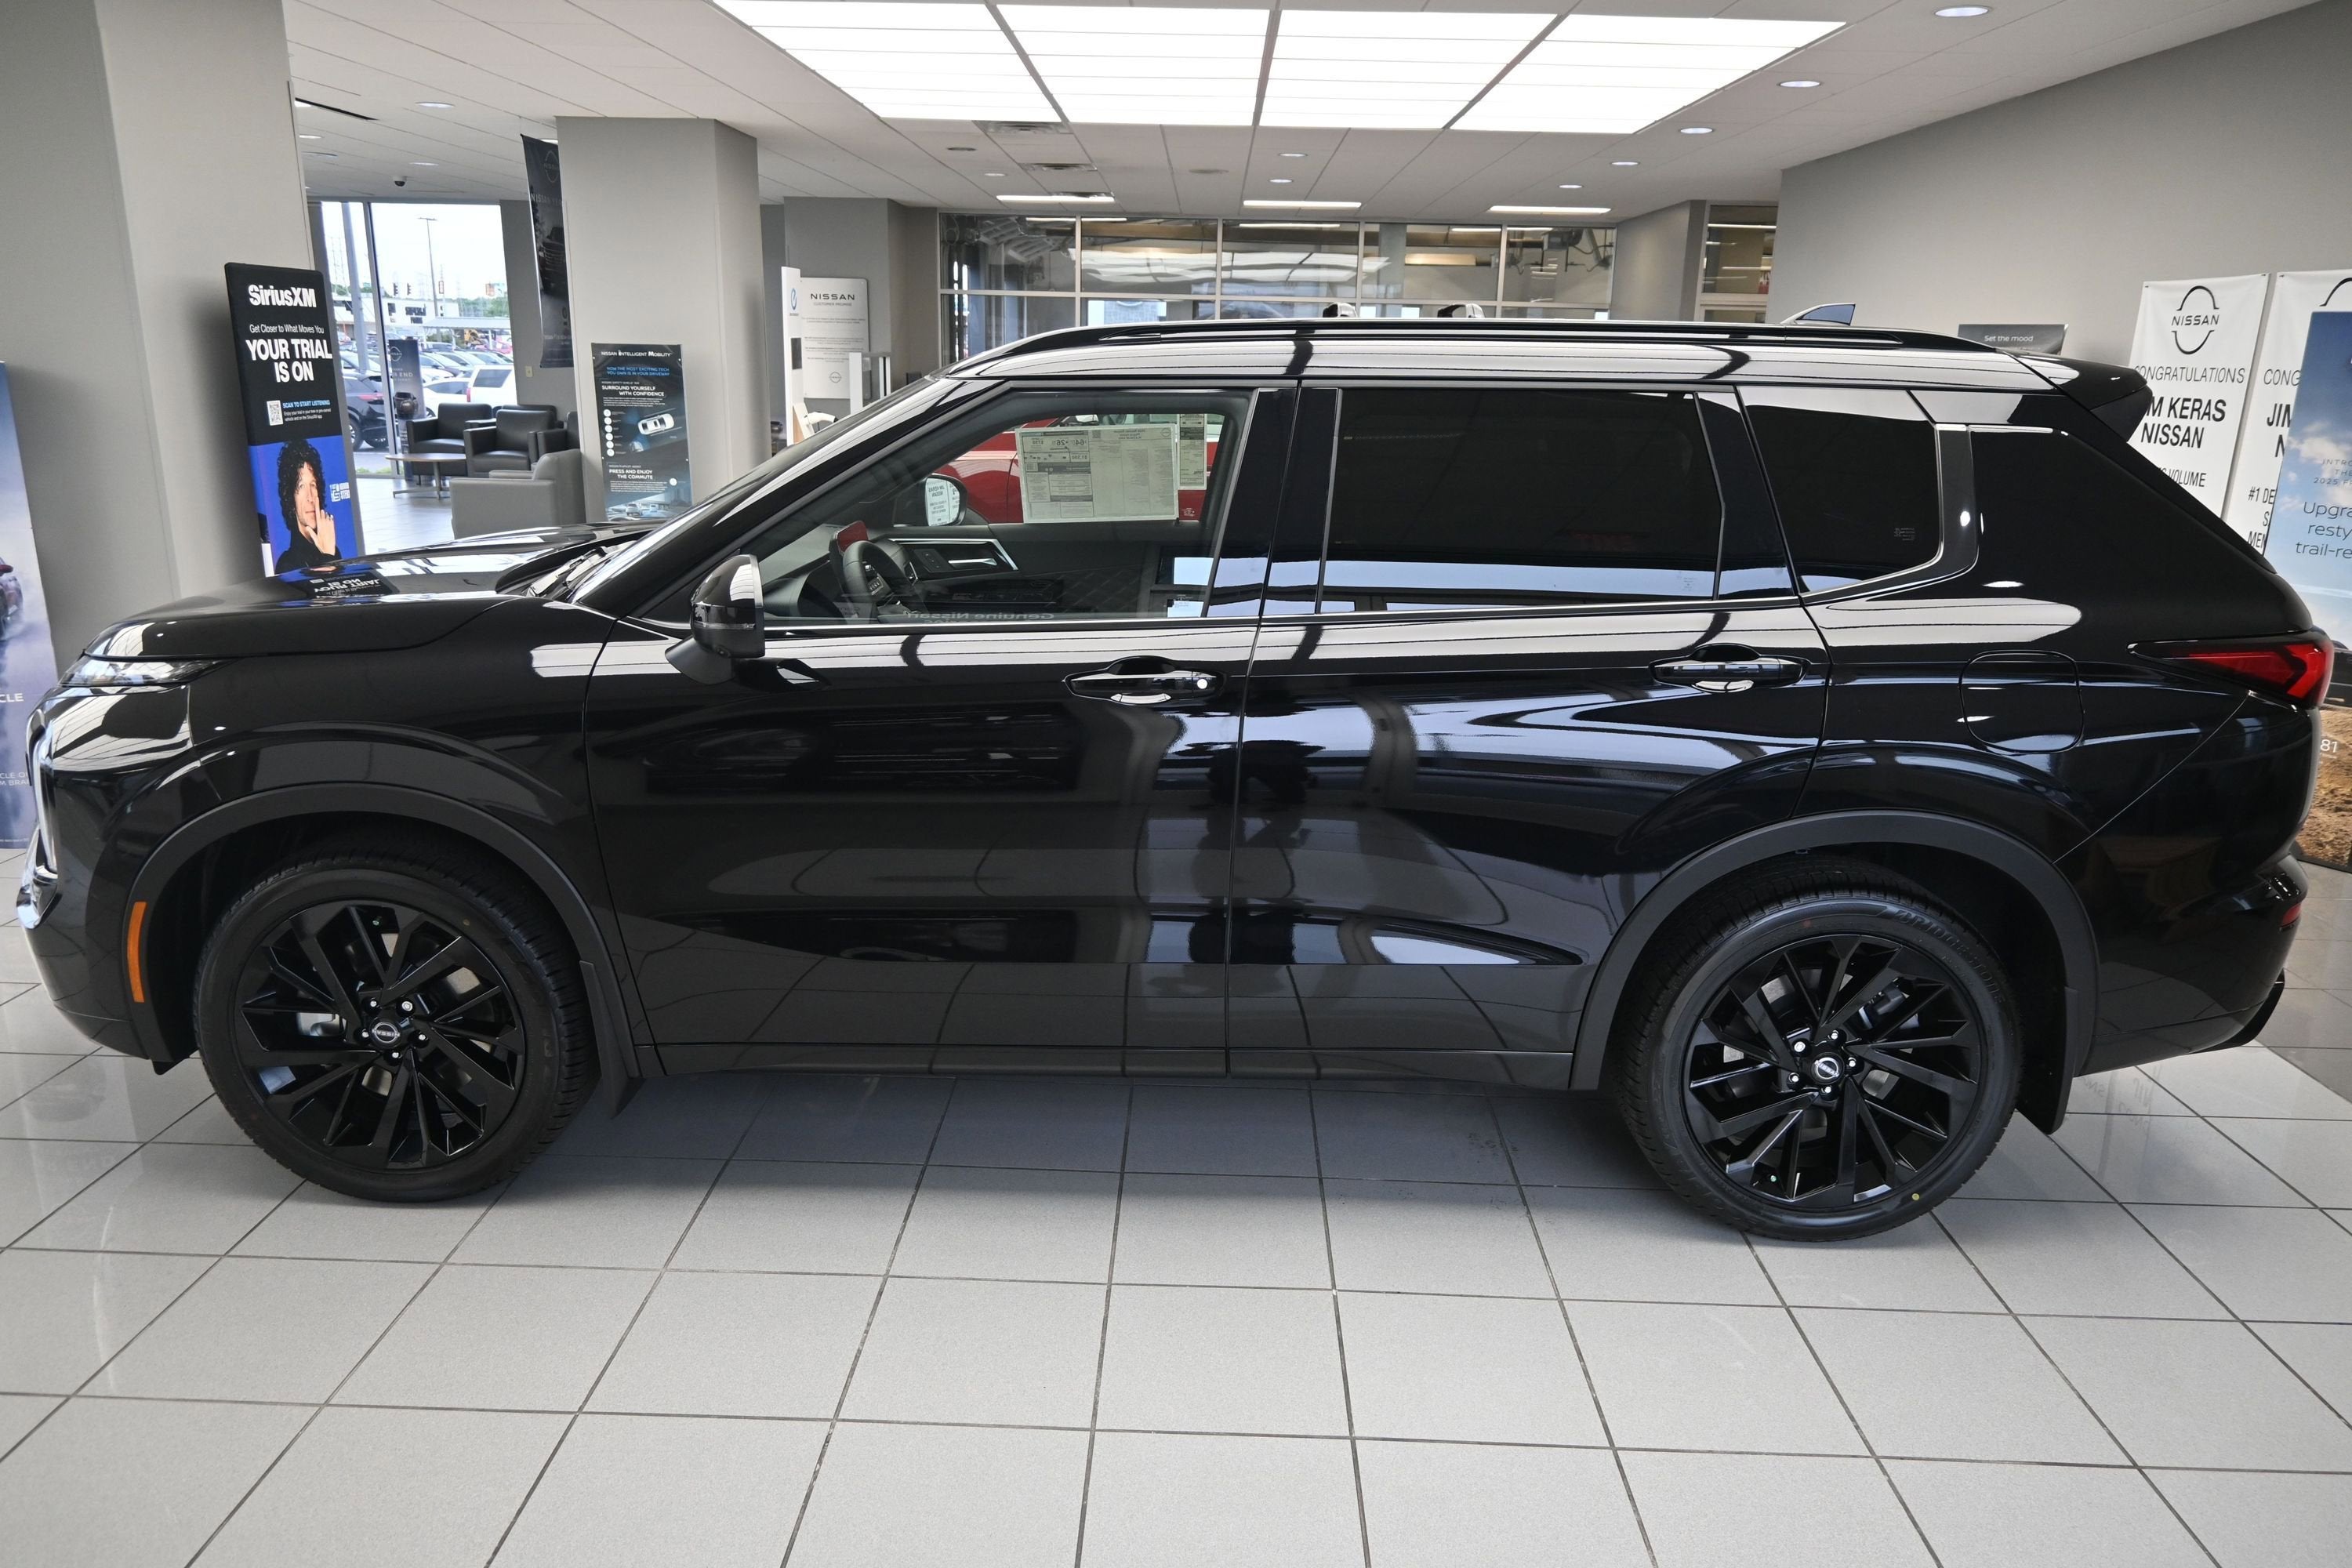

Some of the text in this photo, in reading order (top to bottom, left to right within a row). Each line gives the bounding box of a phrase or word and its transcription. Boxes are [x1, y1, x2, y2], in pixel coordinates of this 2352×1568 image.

[248, 284, 317, 307] SiriusXM
[249, 324, 260, 333] Get
[261, 324, 278, 332] Closer
[299, 325, 314, 333] Moves
[314, 325, 325, 334] You
[2171, 314, 2220, 326] NISSAN
[245, 339, 333, 361] YOUR TRIAL
[274, 361, 314, 383] IS ON
[2168, 397, 2227, 422] KERAS
[2141, 423, 2205, 448] NISSAN
[2314, 477, 2338, 485] 2025
[2248, 486, 2261, 502] #1
[2321, 739, 2337, 753] 81
